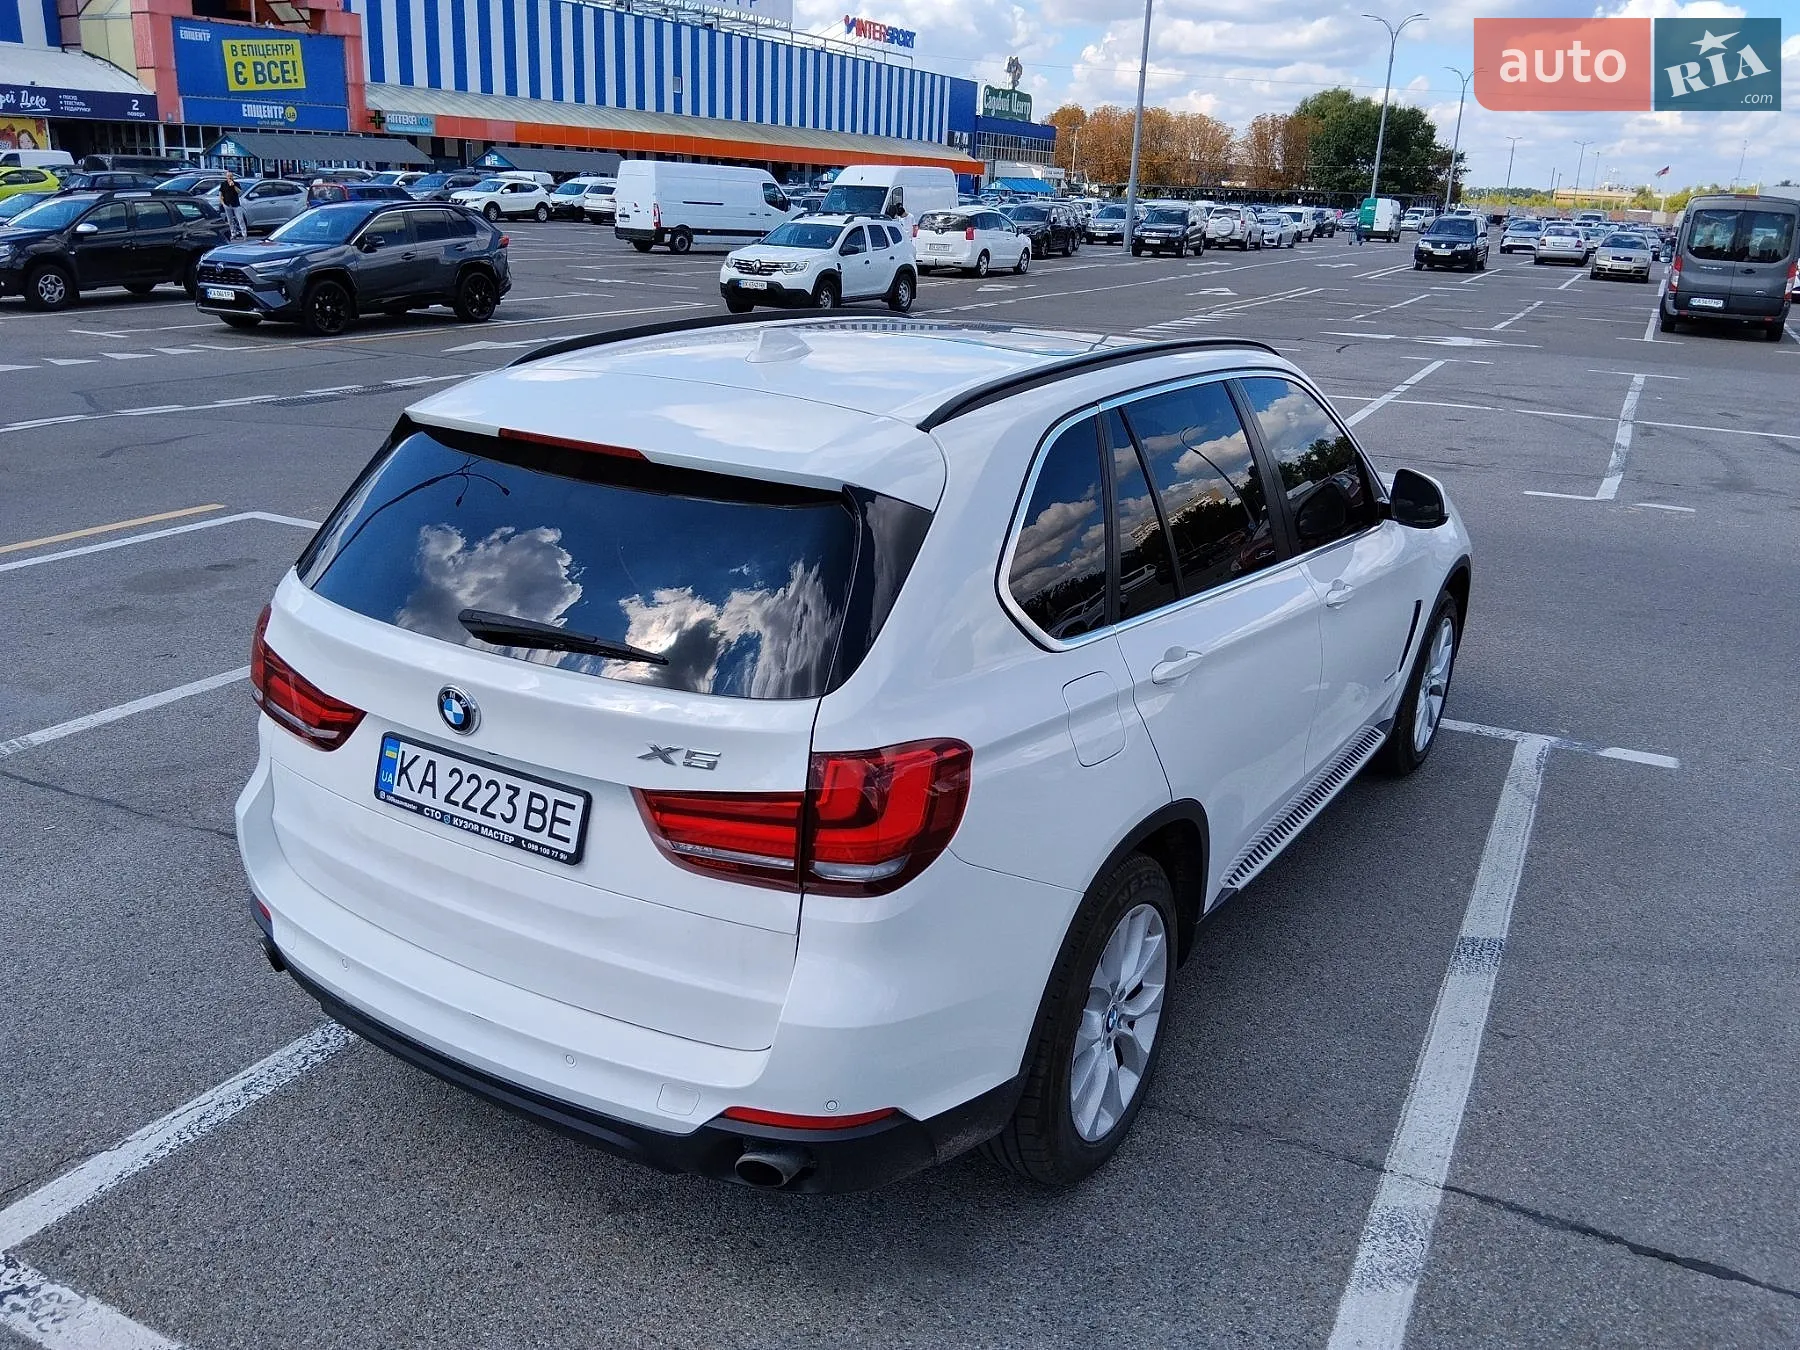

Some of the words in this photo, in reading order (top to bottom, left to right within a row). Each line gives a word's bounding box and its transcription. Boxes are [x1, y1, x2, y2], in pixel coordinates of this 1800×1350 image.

[856, 17, 916, 48] INTERSPORT
[230, 44, 238, 57] В
[241, 44, 295, 58] ЕПІЦЕНТРІ
[233, 61, 248, 85] Є
[252, 60, 299, 85] ВСЕ!
[131, 99, 140, 111] 2
[386, 114, 418, 125] АПТЕКА
[637, 742, 722, 771] X5
[381, 769, 393, 785] UA
[397, 750, 437, 799] KA
[444, 767, 521, 824] 2223
[523, 790, 577, 844] BE
[423, 807, 442, 819] СТО
[480, 826, 515, 844] МАСТЕР
